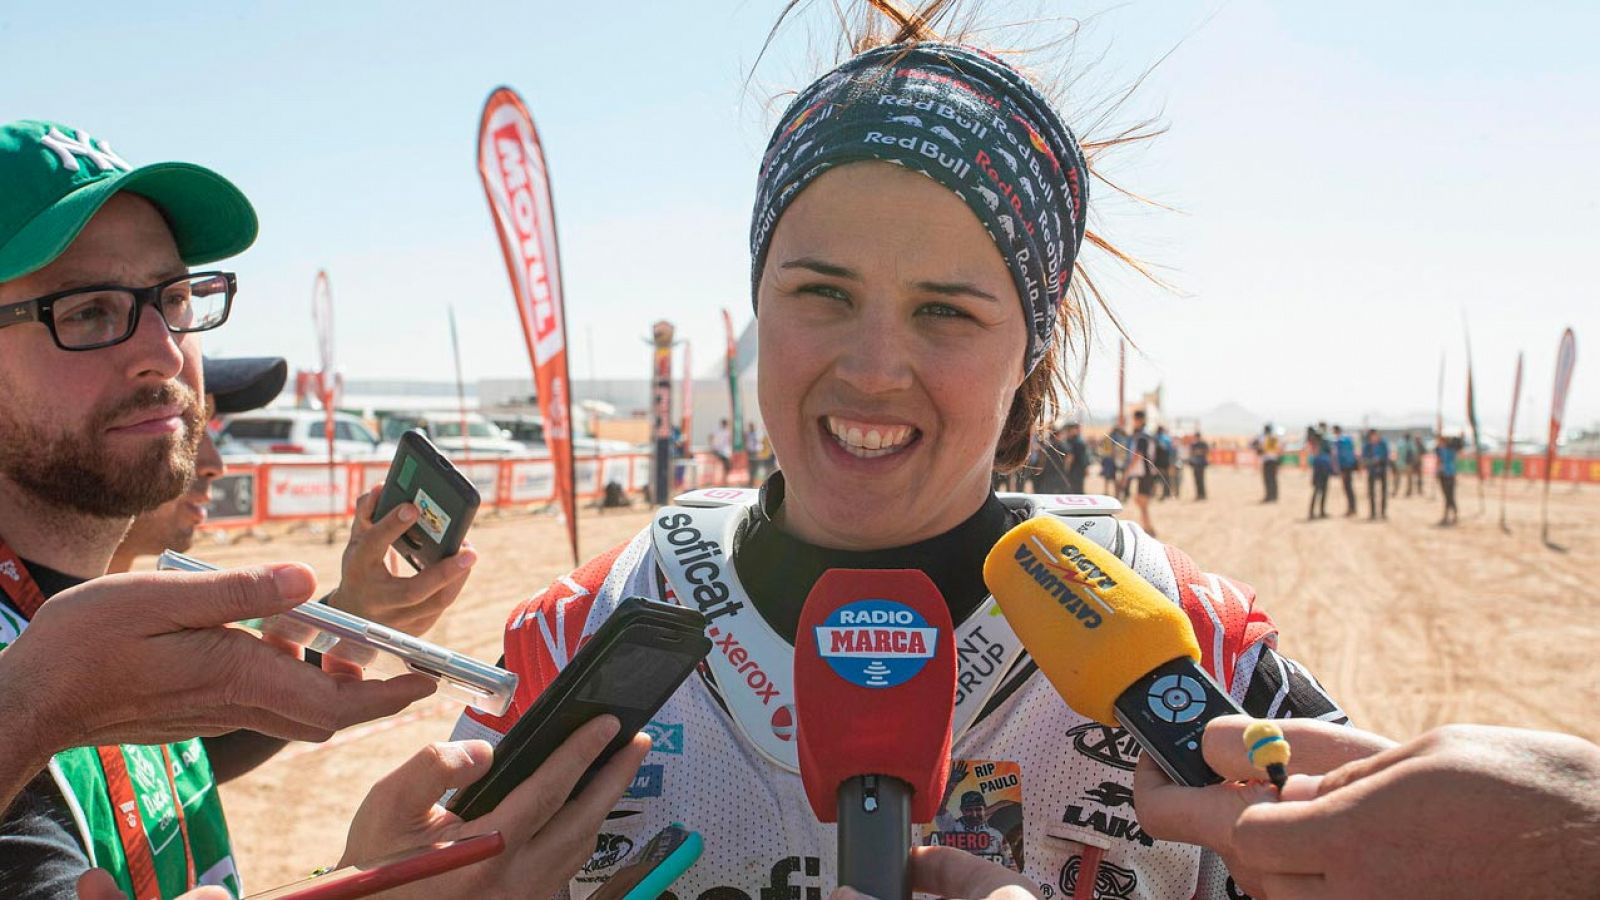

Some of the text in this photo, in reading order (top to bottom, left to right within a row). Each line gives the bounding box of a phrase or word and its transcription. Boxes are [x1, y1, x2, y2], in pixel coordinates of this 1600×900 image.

[878, 95, 988, 140] Red Bull
[864, 132, 971, 180] Red Bull
[975, 150, 1013, 196] Red
[992, 117, 1031, 160] Red
[1029, 156, 1054, 203] Bull
[493, 124, 556, 342] MOTUL
[1038, 209, 1058, 255] Red
[1014, 543, 1104, 629] CATALUNYA
[840, 610, 913, 625] RADIO
[830, 629, 927, 654] MARCA
[715, 632, 781, 706] xerox
[974, 763, 995, 778] RIP
[980, 774, 1018, 794] PAULO
[945, 832, 989, 849] HERO
